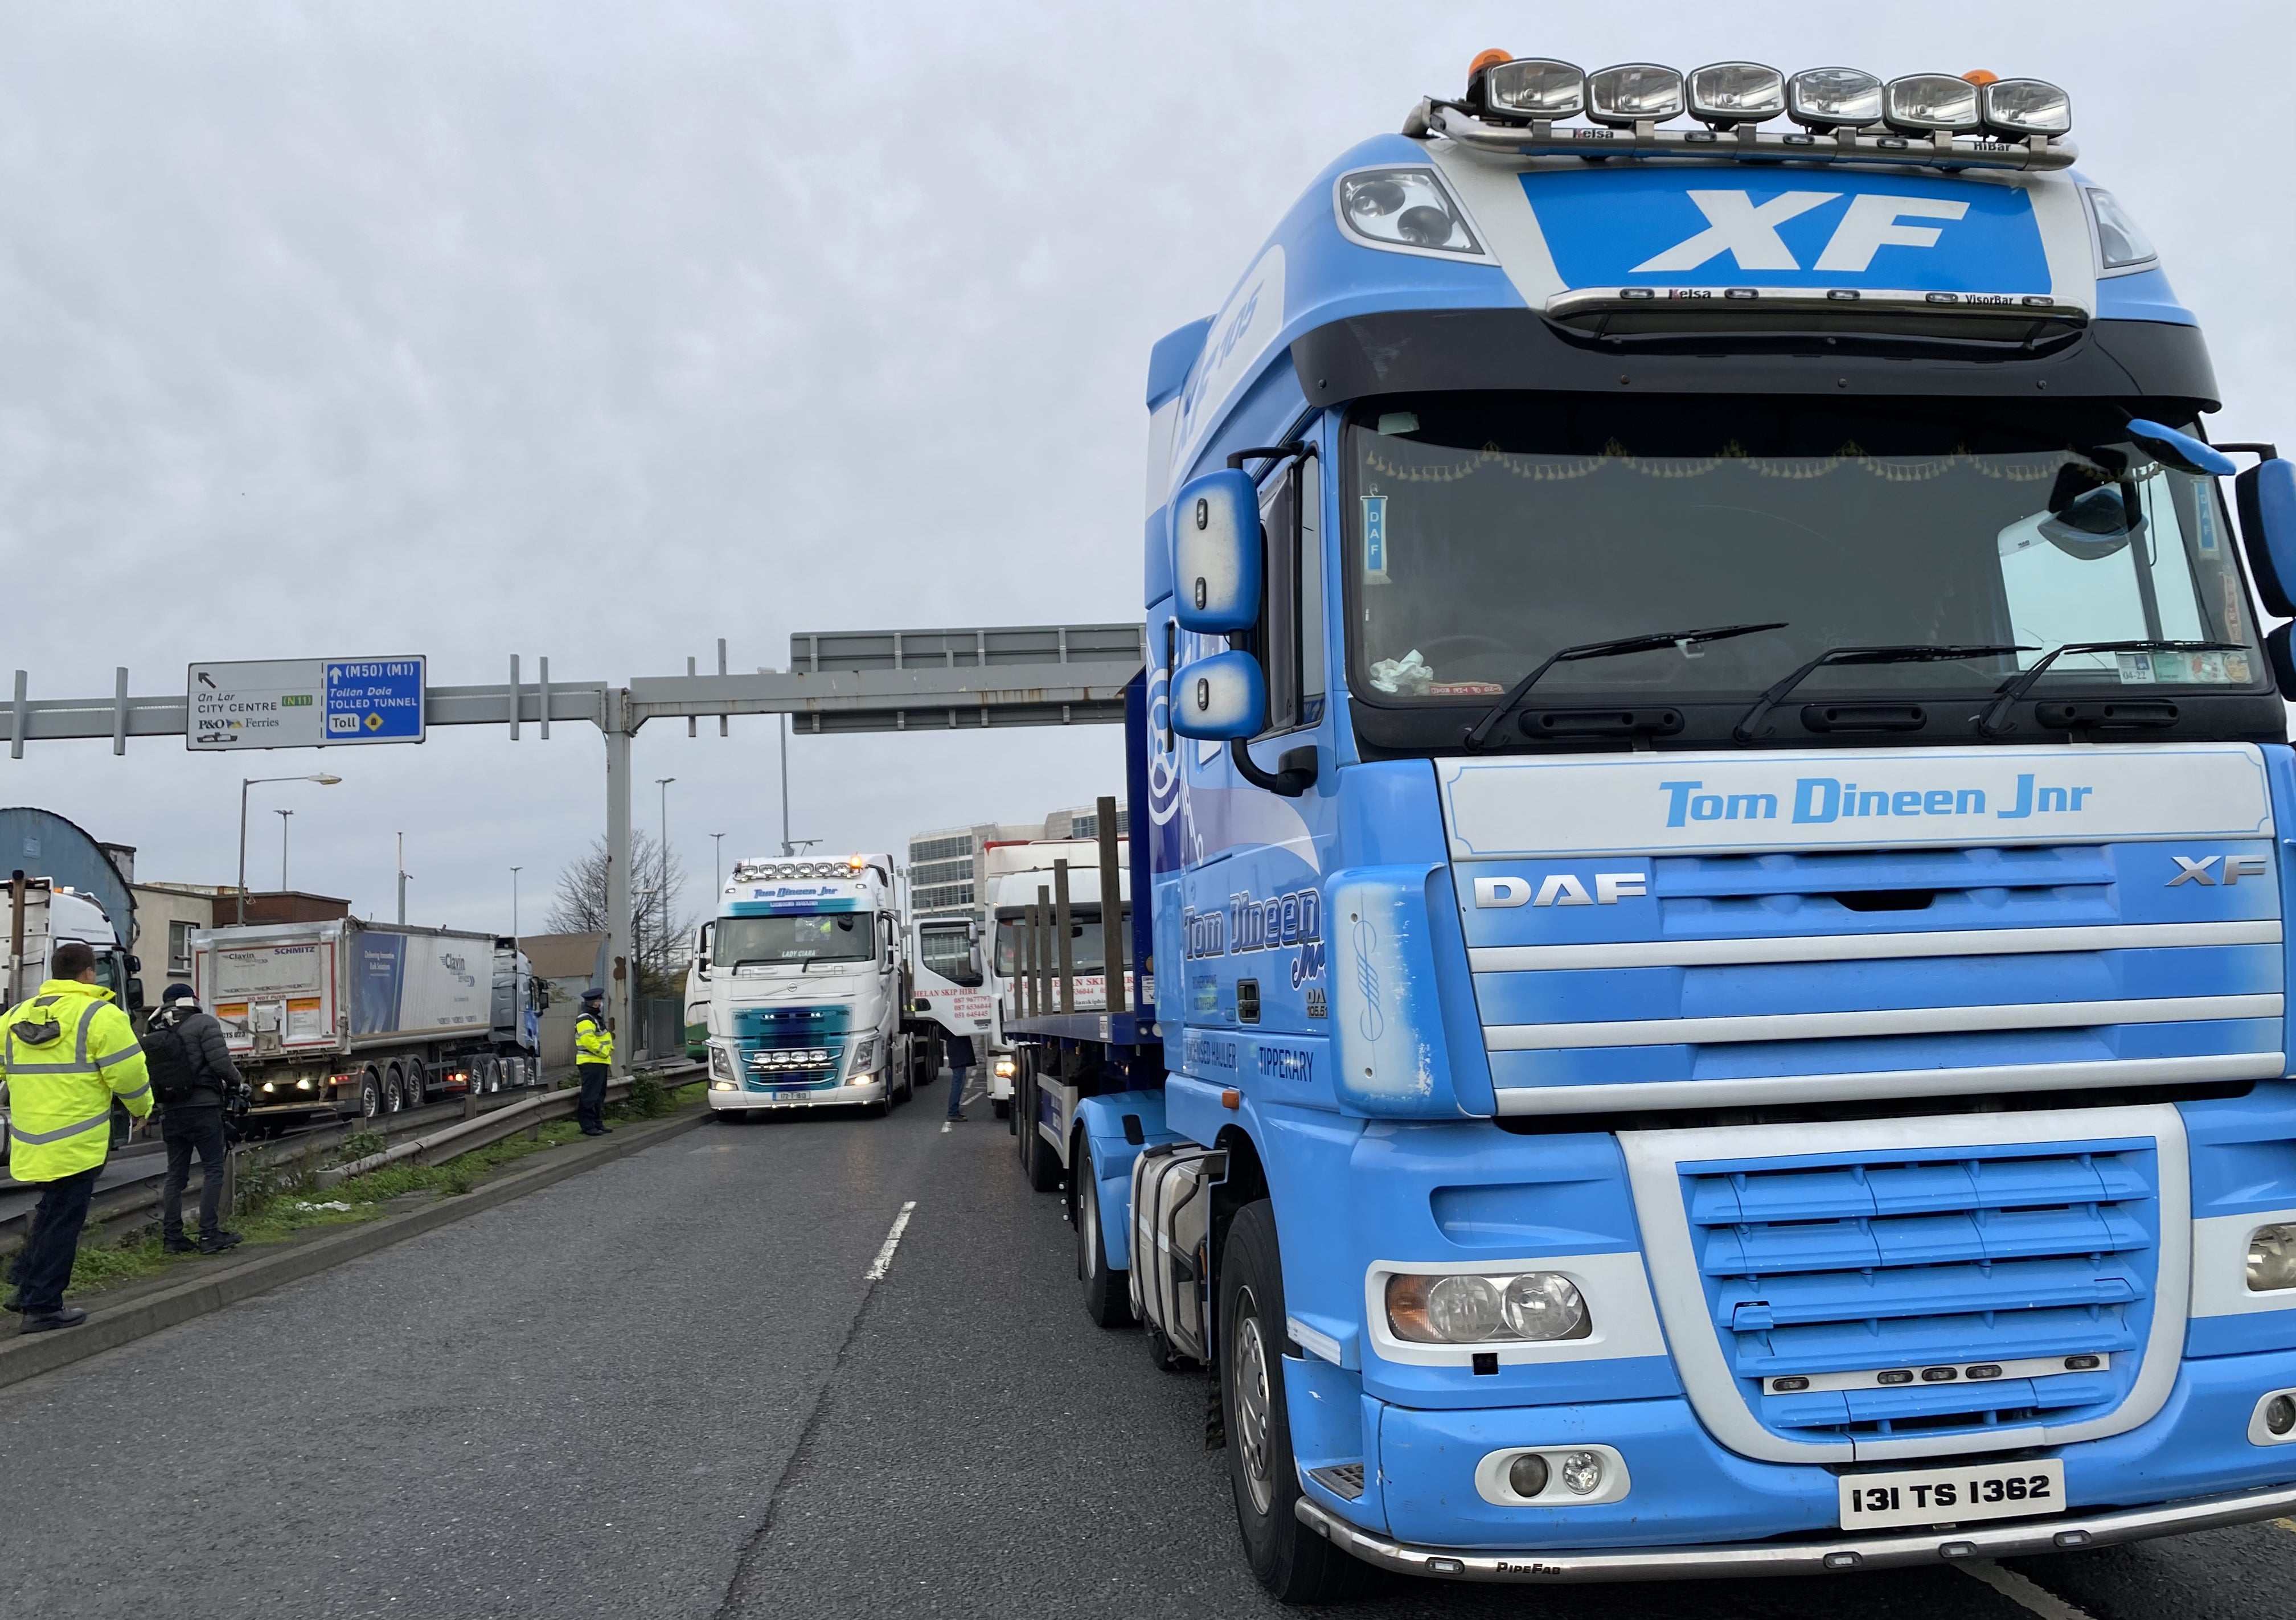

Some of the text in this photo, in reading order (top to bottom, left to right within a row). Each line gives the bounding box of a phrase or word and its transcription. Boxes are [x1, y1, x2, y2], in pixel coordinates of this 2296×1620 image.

[1573, 128, 1614, 138] Kelsa
[1974, 141, 2011, 151] HiBar
[1629, 190, 1970, 273] XF
[1668, 289, 1711, 300] Kelsa
[1965, 294, 2014, 305] VisorBar
[2200, 494, 2210, 535] DAF
[1370, 511, 1380, 555] DAF
[346, 663, 413, 679] (M50) (M1)
[2123, 671, 2146, 680] 04-22
[198, 702, 277, 713] CITY CENTRE
[329, 697, 417, 709] TOLLED TUNNEL
[198, 718, 279, 729] P&O Ferries
[332, 717, 356, 728] Toll
[1659, 773, 2093, 827] Tom Dineen Jnr
[2163, 854, 2267, 887] XF
[754, 886, 838, 899] Tom Dineen Jnr
[1473, 873, 1647, 908] DAF
[1184, 889, 1321, 961] Tom Dineen
[274, 946, 315, 955] SCHMITZ
[445, 953, 465, 970] Clavin
[1306, 987, 1326, 1004] DA
[1259, 1047, 1314, 1082] TIPPERARY
[1852, 1475, 2049, 1512] 131 TS 1362
